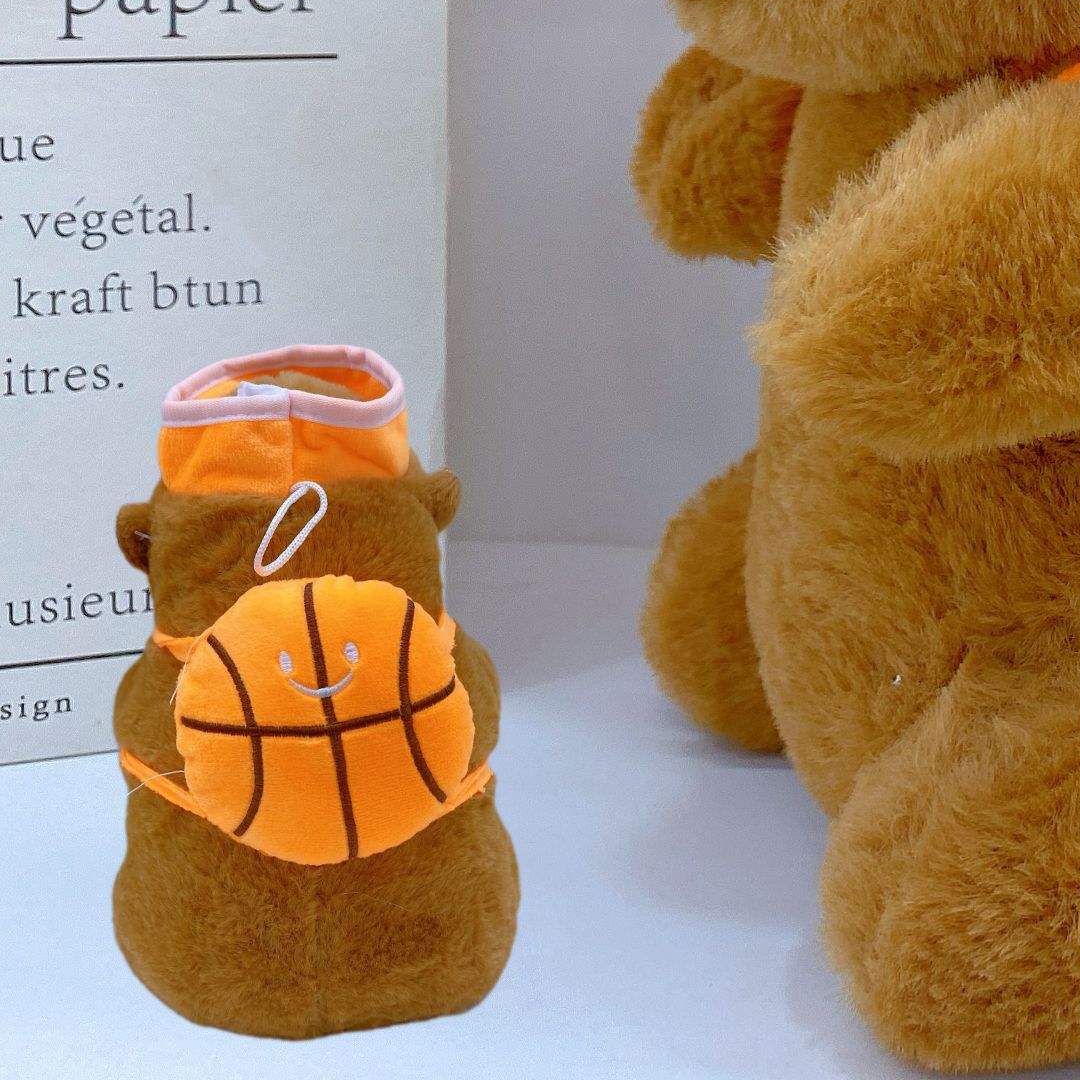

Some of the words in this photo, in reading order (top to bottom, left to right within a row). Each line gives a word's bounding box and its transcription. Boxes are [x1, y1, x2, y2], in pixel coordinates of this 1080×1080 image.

[0, 133, 56, 163] ue
[12, 271, 134, 319] kraft
[2, 357, 125, 397] itres.
[0, 694, 73, 722] sign
